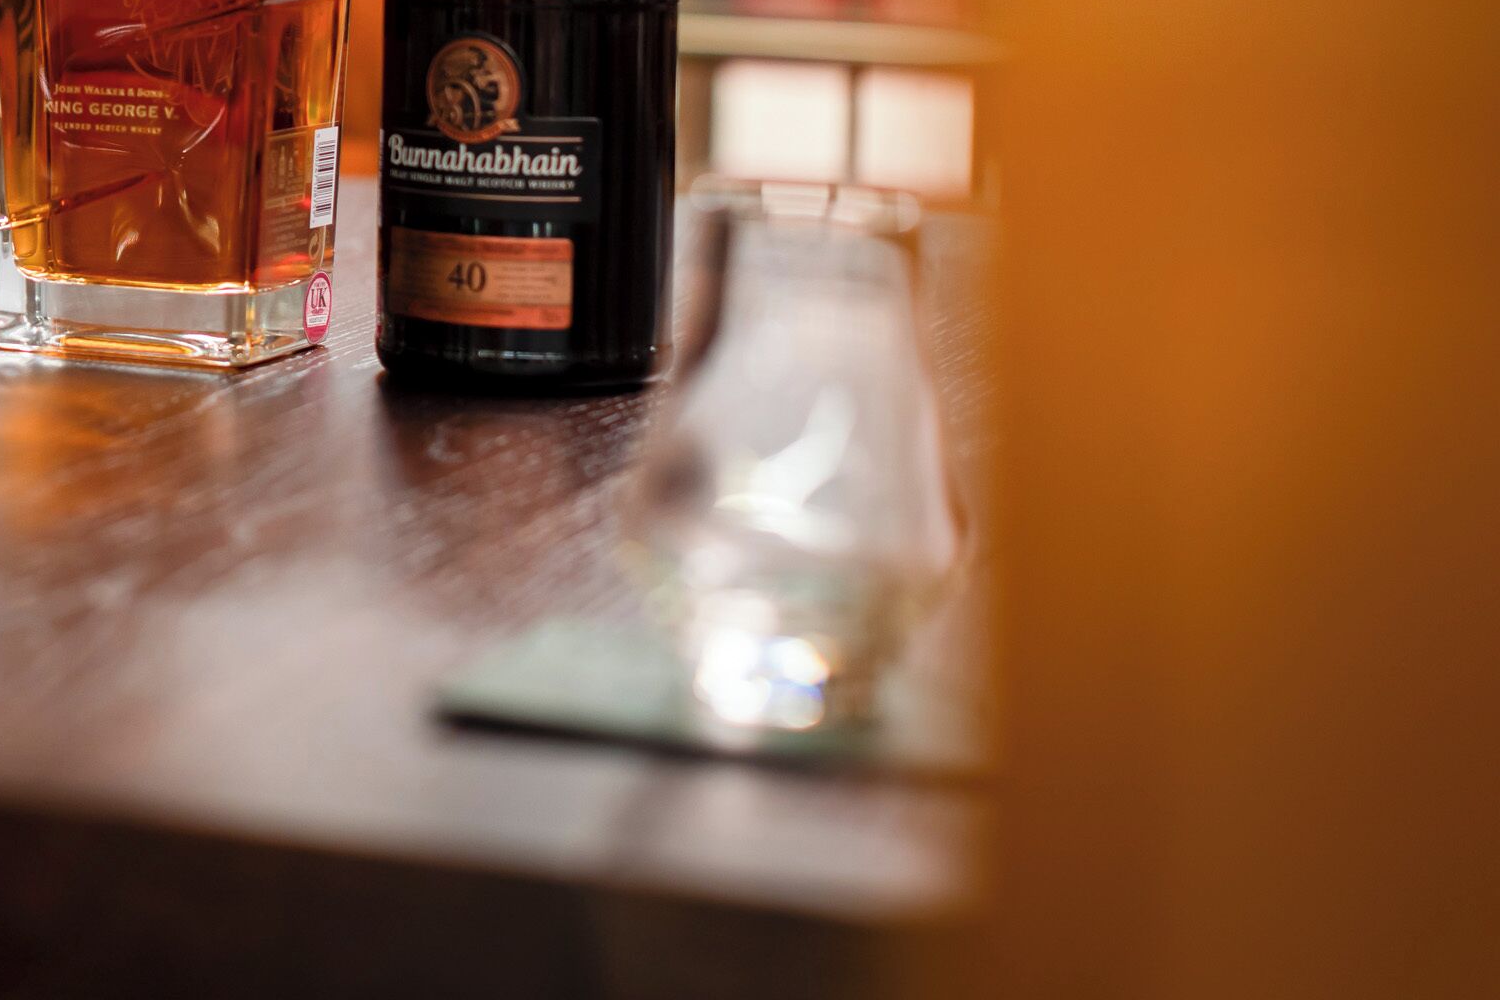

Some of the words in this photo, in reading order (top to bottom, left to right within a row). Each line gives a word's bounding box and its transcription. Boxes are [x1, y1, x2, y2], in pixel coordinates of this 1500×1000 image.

[43, 99, 83, 115] KING
[89, 102, 158, 119] GEORGE
[387, 133, 584, 177] Bunnahabhain
[446, 261, 487, 293] 40
[311, 286, 328, 309] UK
